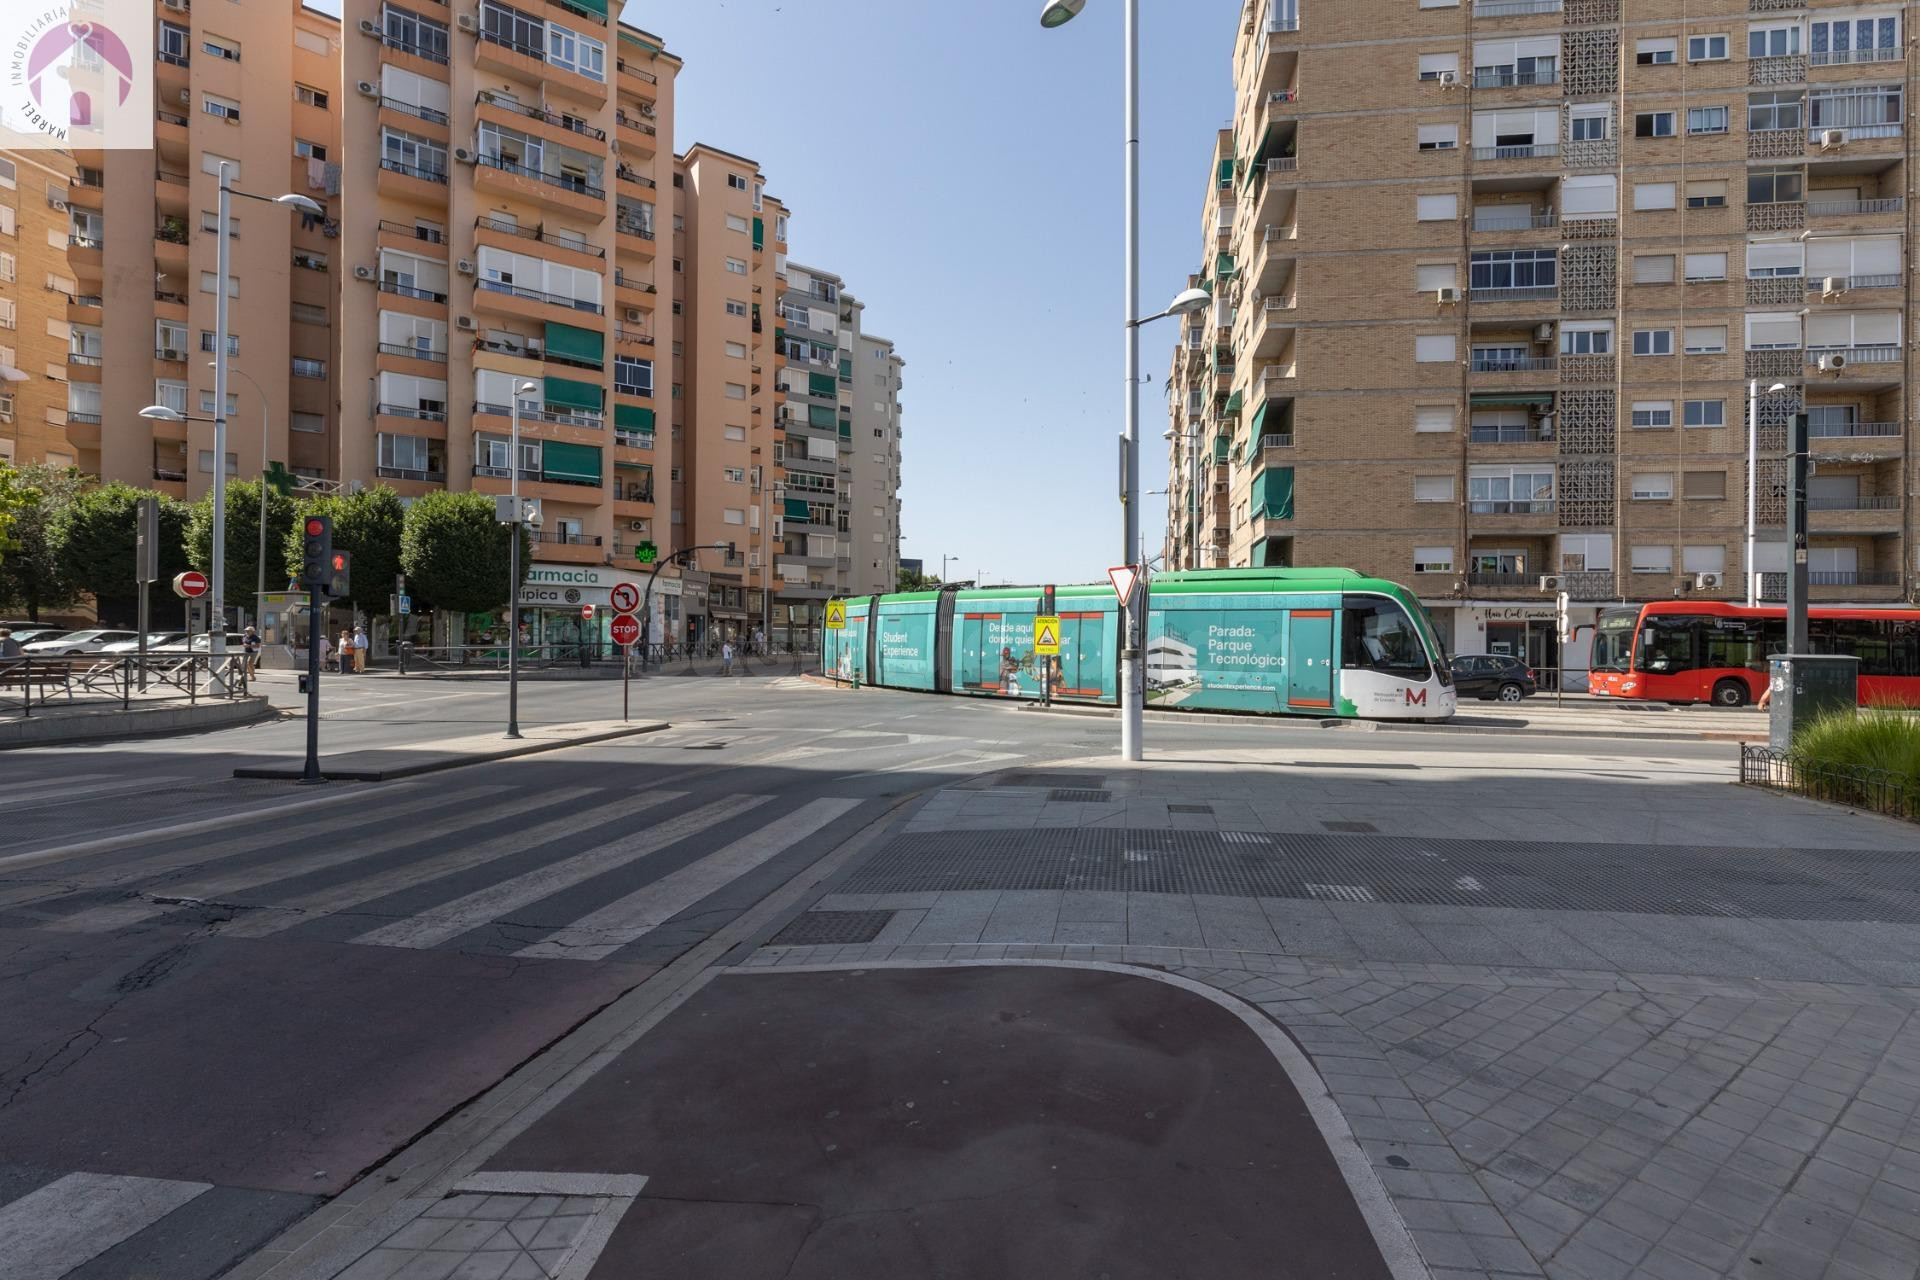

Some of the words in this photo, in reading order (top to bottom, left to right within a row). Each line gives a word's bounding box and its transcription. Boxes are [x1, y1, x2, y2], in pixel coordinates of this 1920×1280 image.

[527, 569, 598, 583] armacia
[613, 625, 637, 633] STOP
[989, 623, 1014, 633] Desde
[1208, 625, 1256, 637] Parada:
[883, 631, 908, 643] Student
[988, 634, 1014, 644] donde
[883, 644, 919, 658] Experience
[1208, 639, 1253, 653] Parque
[1208, 652, 1287, 668] Tecnológico
[1406, 687, 1427, 706] M
